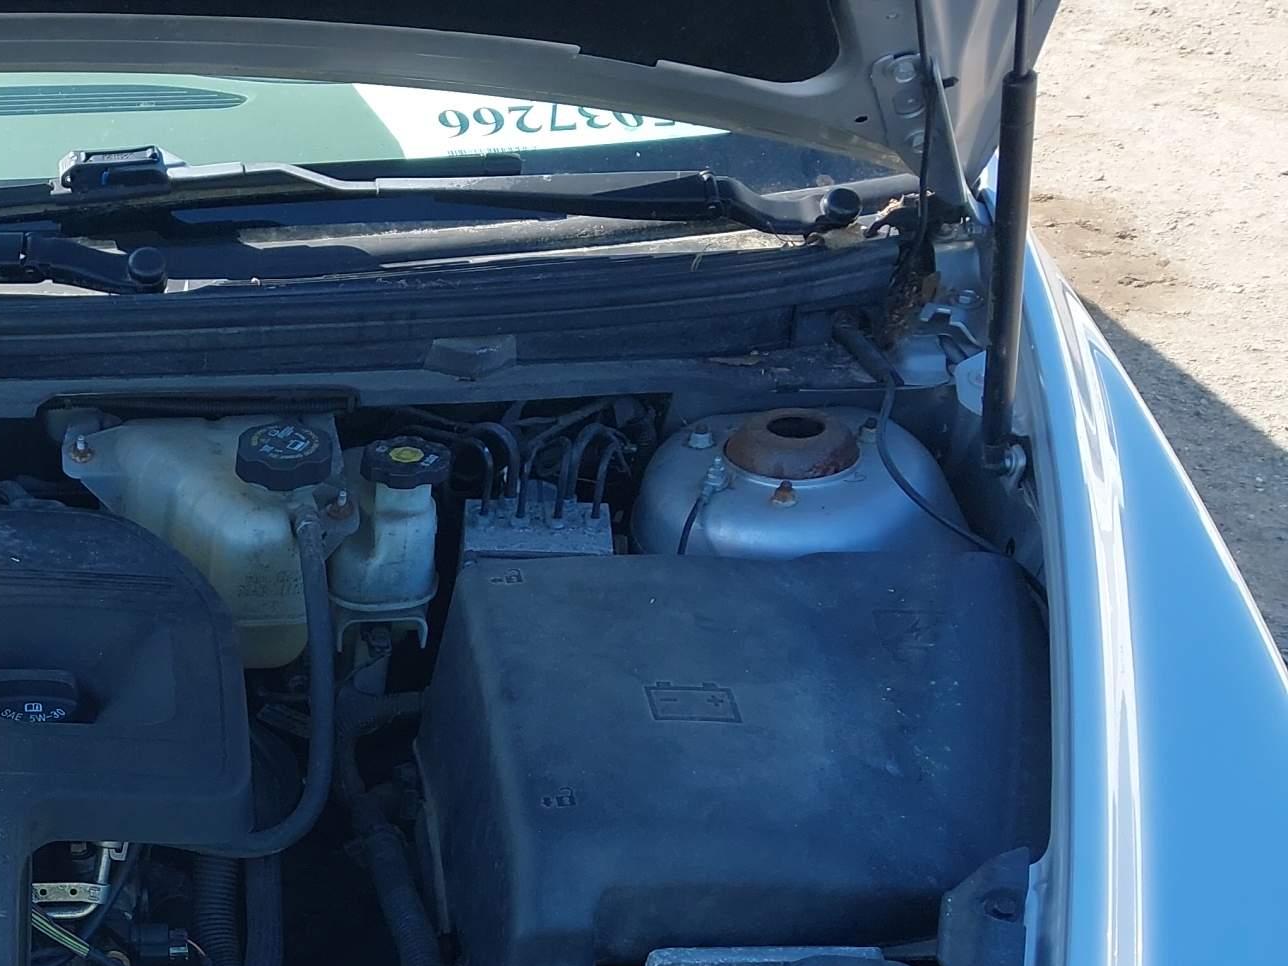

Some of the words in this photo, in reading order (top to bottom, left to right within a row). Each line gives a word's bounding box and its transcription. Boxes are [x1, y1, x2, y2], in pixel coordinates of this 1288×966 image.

[438, 103, 676, 138] 037266
[0, 708, 24, 721] SAE
[29, 708, 66, 722] 5W-30
